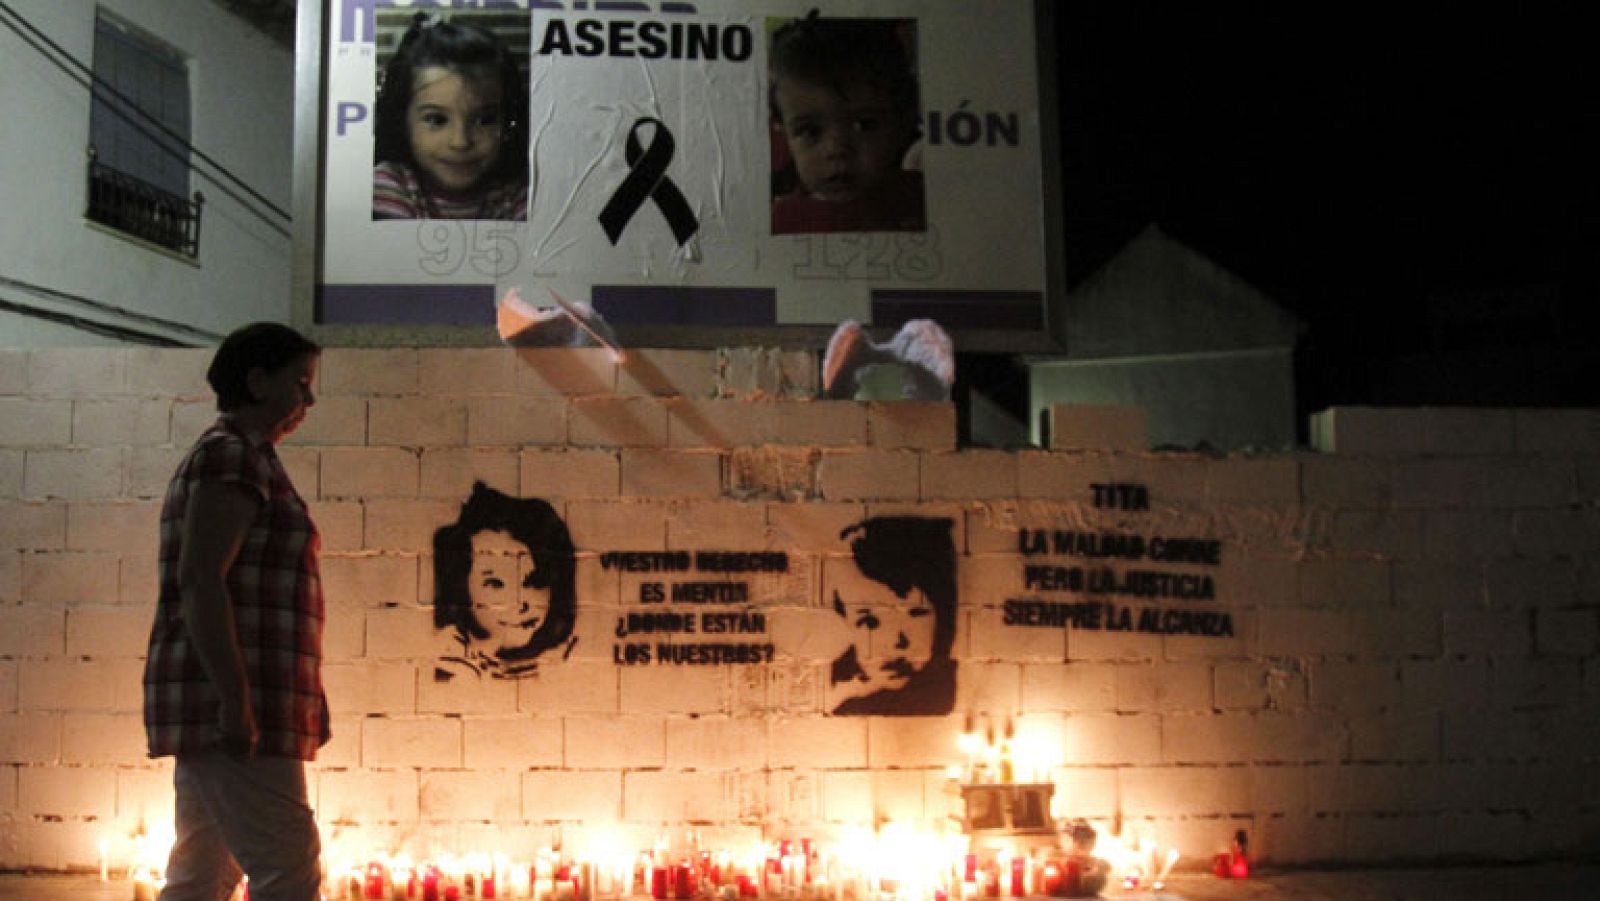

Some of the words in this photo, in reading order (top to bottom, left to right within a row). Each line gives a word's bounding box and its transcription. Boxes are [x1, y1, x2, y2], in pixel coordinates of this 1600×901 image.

[539, 18, 753, 61] ASESINO
[926, 100, 1020, 147] IÓN
[1090, 483, 1149, 511] TITA
[695, 551, 789, 572] DERECHO
[1018, 528, 1047, 555] LA
[1053, 530, 1146, 559] MALDAD
[1149, 537, 1222, 565] CORRE
[640, 582, 665, 603] ES
[1024, 565, 1084, 592] PERO
[1087, 567, 1115, 593] LA
[1115, 570, 1215, 600] JUSTICIA
[702, 609, 767, 634] ESTÁN
[1003, 599, 1104, 630] SIEMPRE
[1105, 605, 1132, 632] LA
[1136, 607, 1234, 637] ALCANZA
[613, 644, 652, 665] LOS
[657, 643, 775, 665] NUESTROS?
